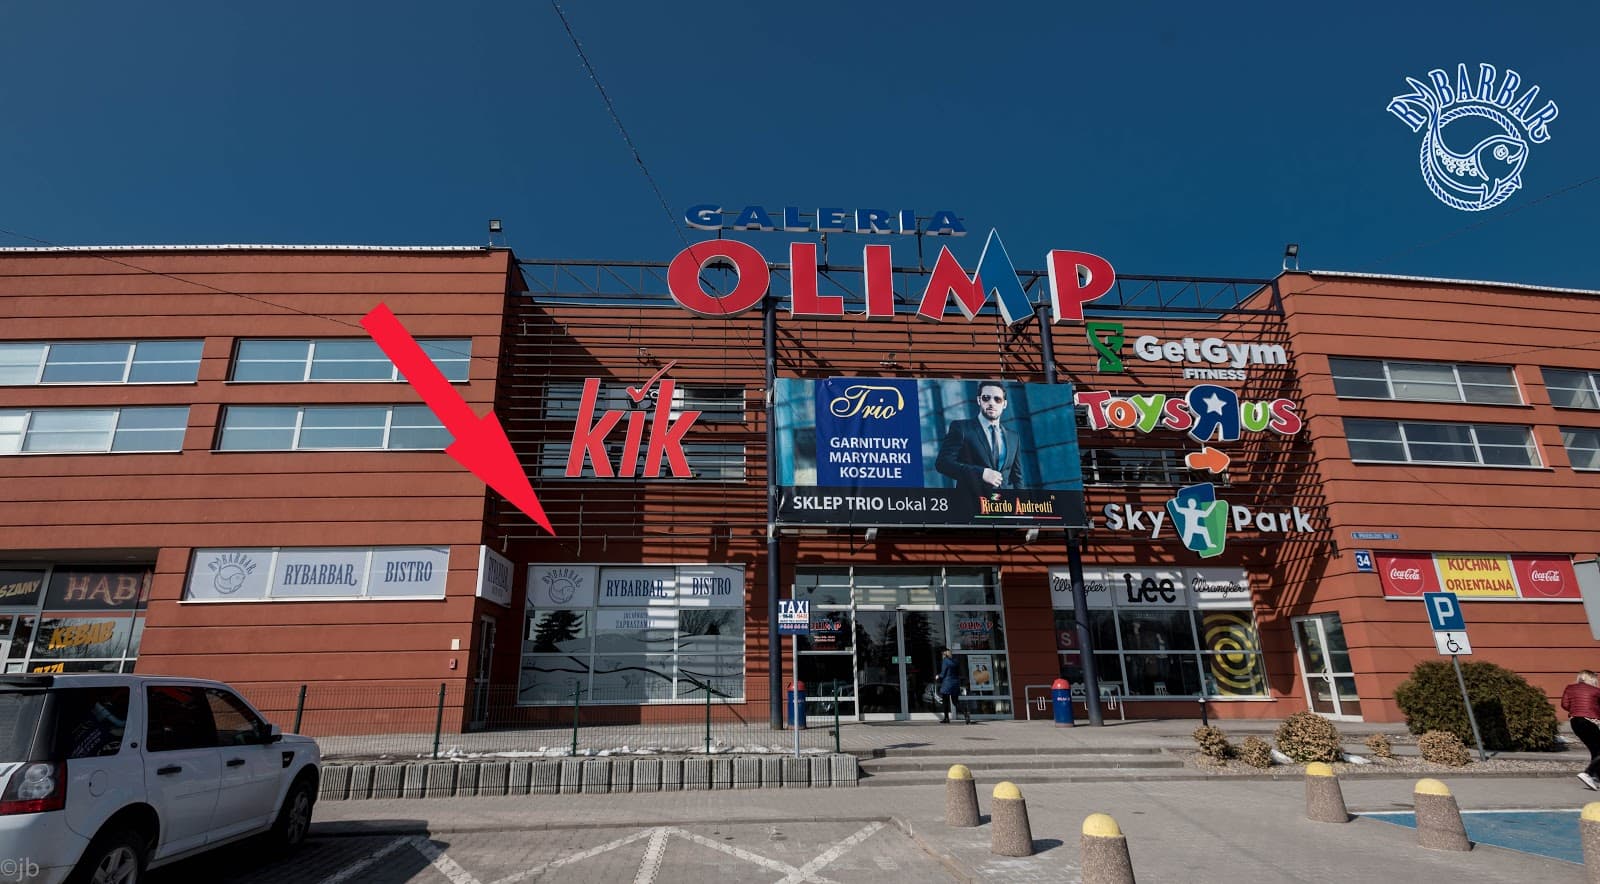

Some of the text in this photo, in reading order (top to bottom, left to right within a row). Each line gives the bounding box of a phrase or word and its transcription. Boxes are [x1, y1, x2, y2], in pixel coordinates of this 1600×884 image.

[685, 204, 967, 237] GALERIA
[667, 228, 1116, 328] OLIMP
[1133, 335, 1287, 368] GetGym
[1184, 368, 1246, 380] FITNESS
[830, 385, 904, 419] Trio
[830, 437, 908, 449] GARNITURY
[829, 452, 911, 464] MARYNARKI
[840, 466, 902, 479] KOSZULE
[793, 496, 949, 512] SKLEP TRIO Lokal 28
[979, 496, 1012, 514] Ricardo
[1103, 503, 1314, 539] Sky Park
[1356, 554, 1371, 567] 34
[1448, 558, 1501, 571] KUCHNIA
[283, 563, 357, 586] RYBARBAR
[384, 561, 433, 583] BISTRO
[606, 580, 668, 598] RYBARBAR
[692, 577, 731, 596] BISTRO
[1124, 573, 1176, 603] Lee
[1192, 577, 1245, 597] Wrangler
[1446, 579, 1514, 591] ORIENTALNA
[778, 600, 809, 613] TAXI
[1433, 597, 1455, 625] P
[48, 621, 115, 650] KEBAB
